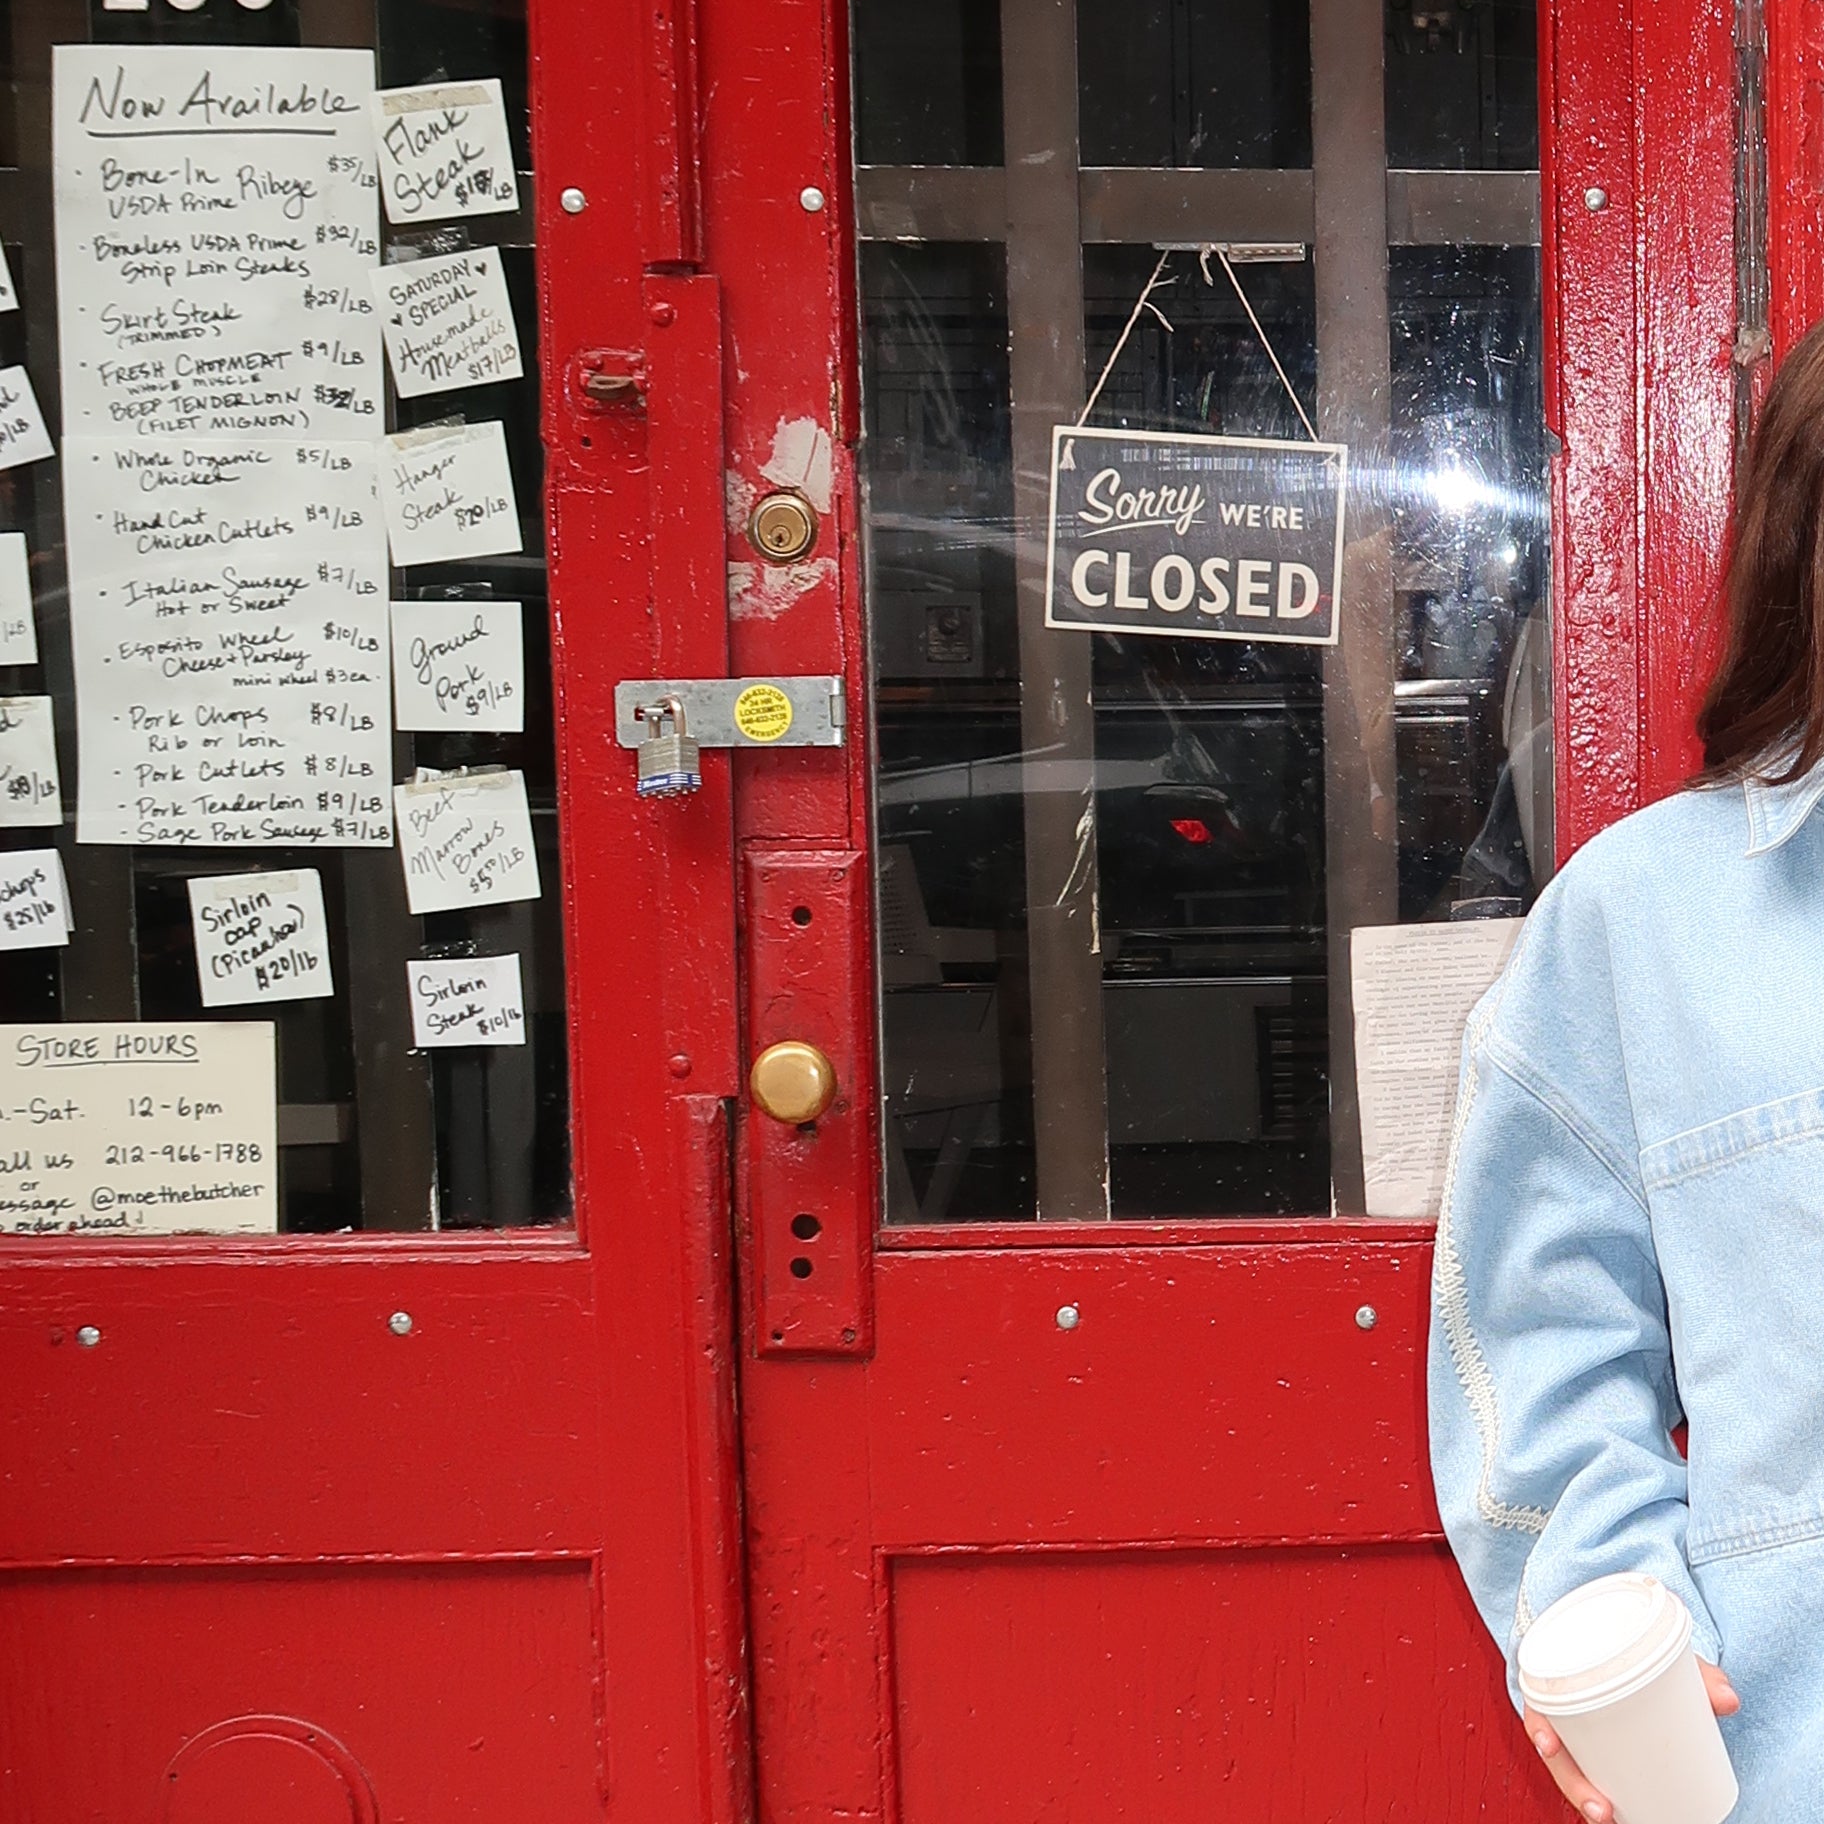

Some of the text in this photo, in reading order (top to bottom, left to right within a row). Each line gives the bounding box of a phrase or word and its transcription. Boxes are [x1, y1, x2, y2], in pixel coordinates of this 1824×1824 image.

[79, 66, 360, 125] Now Available
[383, 109, 469, 165] Flank
[100, 157, 219, 192] Bone-In
[237, 164, 318, 220] Ribeye
[394, 139, 485, 214] Steak
[108, 193, 237, 219] USDA Prime
[93, 233, 307, 262] Boneless USDA Prime
[120, 256, 311, 288] Strip Loin Steaks
[389, 259, 472, 306] SATURDAY
[100, 284, 373, 335] Skirt Steak $28/LB
[408, 283, 477, 326] SPECIAL
[97, 340, 364, 387] FRESH CHOPMEAT $9/LB
[421, 320, 506, 382] Meatballs
[126, 372, 261, 395] WHOLE MUSCLE
[167, 387, 301, 413] TENDERLOIN
[137, 409, 311, 436] (FILET MIGNON)
[113, 448, 353, 480] Whole Organic $5/LB
[394, 455, 457, 494] Hanger
[140, 470, 242, 492] Chicken
[402, 488, 464, 531] Steak
[1078, 468, 1304, 536] Sorry WE'RE
[112, 504, 364, 534] Hand Cut $9/LB
[136, 521, 295, 554] Chicken Cutlets
[120, 562, 378, 607] Italian Sausage $7/LB
[1071, 549, 1320, 619] CLOSED
[156, 594, 292, 618] Hot or Sweet
[119, 622, 380, 662] Esposito Wheel $10/LB
[410, 615, 489, 685] Ground
[232, 674, 272, 687] mini
[278, 670, 318, 687] wheel
[436, 664, 484, 713] Pork
[129, 703, 374, 732] Pork Chops $8/LB
[739, 704, 786, 717] LOCKSMITH
[148, 734, 188, 753] Rib
[202, 736, 223, 748] or
[134, 763, 186, 787] Pork
[199, 761, 285, 778] Cutlets
[134, 791, 383, 822] Pork Tenderloin $9/LB
[408, 787, 455, 838] Beef
[136, 817, 390, 844] Sage Pork Sausage $7/LB
[411, 817, 474, 881] Marrow
[452, 820, 504, 874] Bones
[201, 892, 272, 933] Sirloin
[224, 916, 262, 946] cap
[418, 975, 488, 1006] Sirloin
[427, 1004, 484, 1035] Steak
[17, 1033, 199, 1067] STORE HOURS
[44, 1156, 74, 1169] us
[105, 1144, 262, 1165] 212-966-1788
[20, 1181, 39, 1191] or
[91, 1181, 265, 1211] @moethebutcher
[16, 1218, 65, 1232] order
